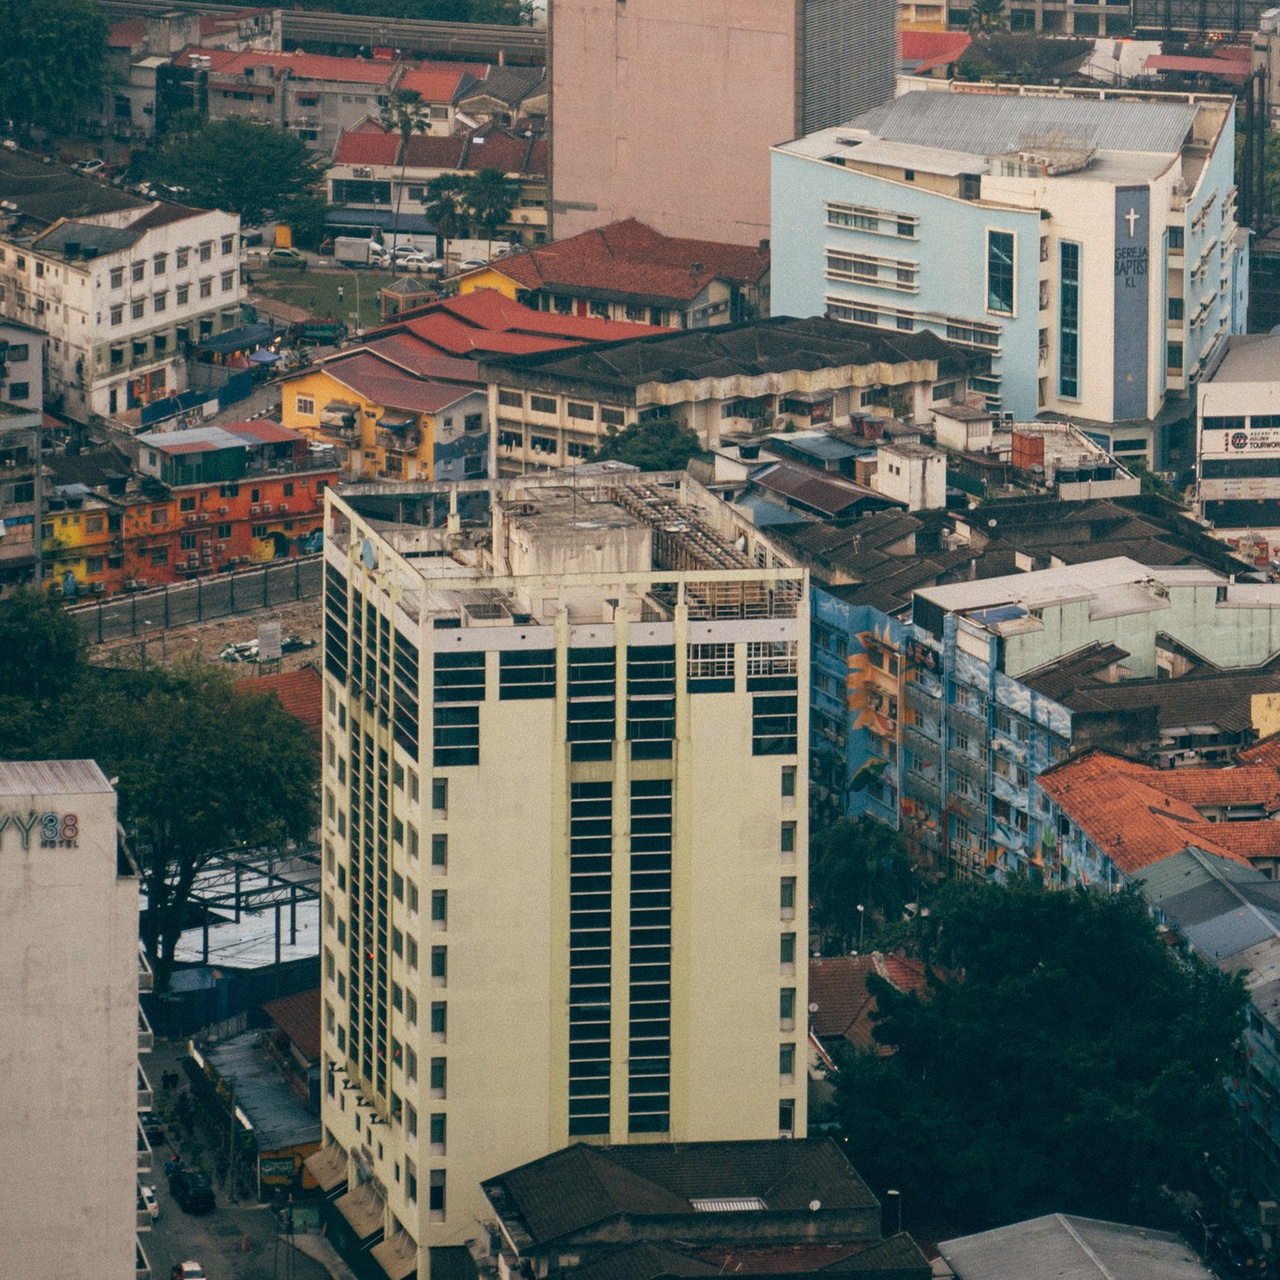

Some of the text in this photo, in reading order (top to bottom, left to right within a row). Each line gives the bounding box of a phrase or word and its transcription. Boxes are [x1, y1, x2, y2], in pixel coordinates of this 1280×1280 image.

[1115, 246, 1148, 259] GEREJA
[1115, 258, 1148, 276] BAPTIST
[1125, 277, 1136, 288] KL
[41, 840, 79, 848] HOTEL
